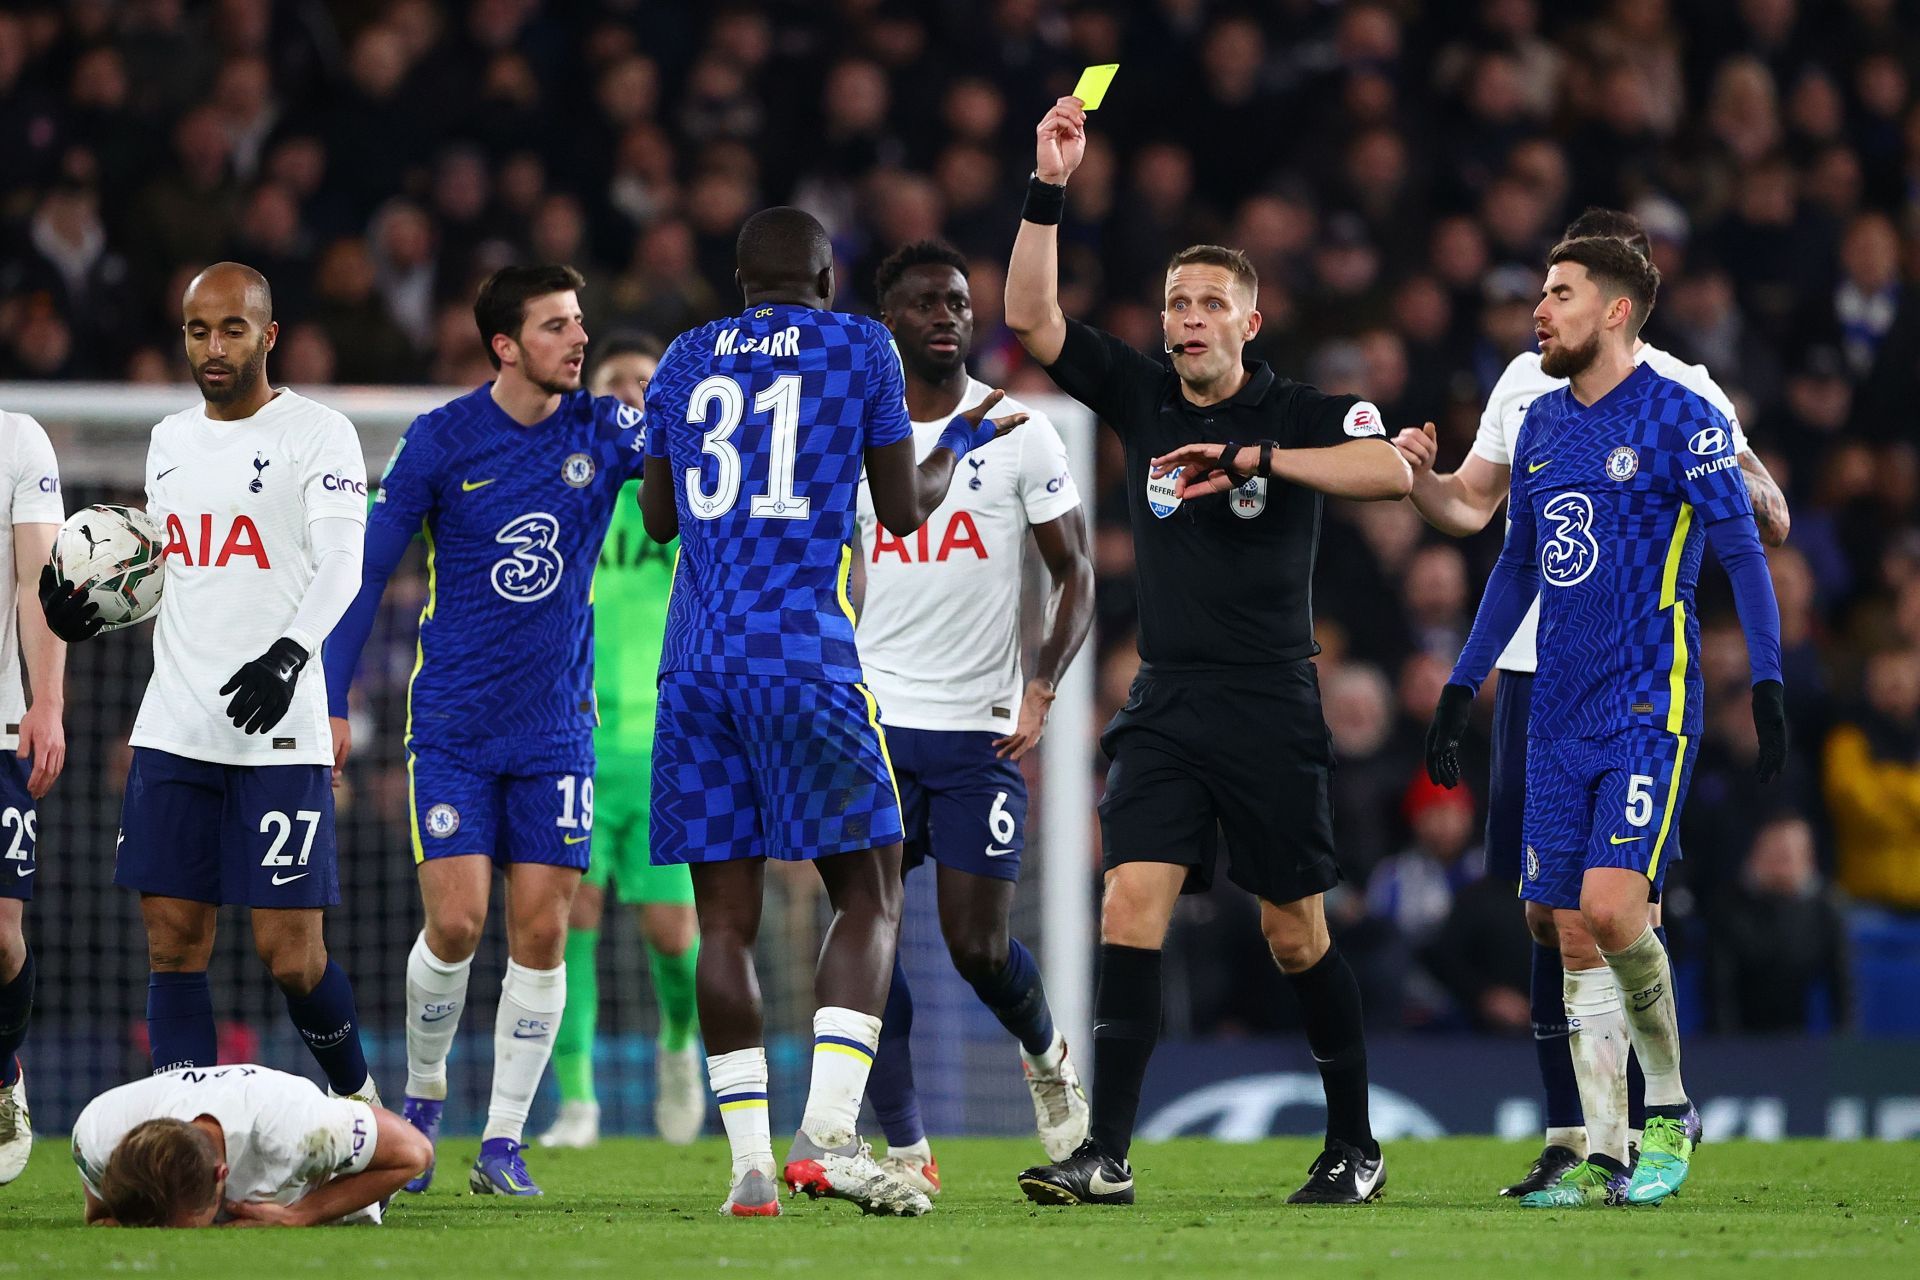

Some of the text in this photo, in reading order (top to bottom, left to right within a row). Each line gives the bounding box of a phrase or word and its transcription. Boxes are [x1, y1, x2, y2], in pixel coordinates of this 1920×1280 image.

[755, 308, 774, 319] CFC
[686, 375, 811, 521] 31
[1150, 484, 1178, 497] REFERE
[1239, 499, 1256, 508] EFL
[1154, 504, 1169, 514] 2021
[162, 513, 271, 569] AIA
[871, 510, 989, 563] AIA
[556, 775, 594, 831] 19
[1625, 774, 1653, 827] 5
[989, 792, 1015, 845] 6
[260, 810, 321, 867] 27
[424, 1002, 457, 1014] CFC
[1632, 983, 1662, 1001] CFC
[517, 1018, 551, 1031] CFC
